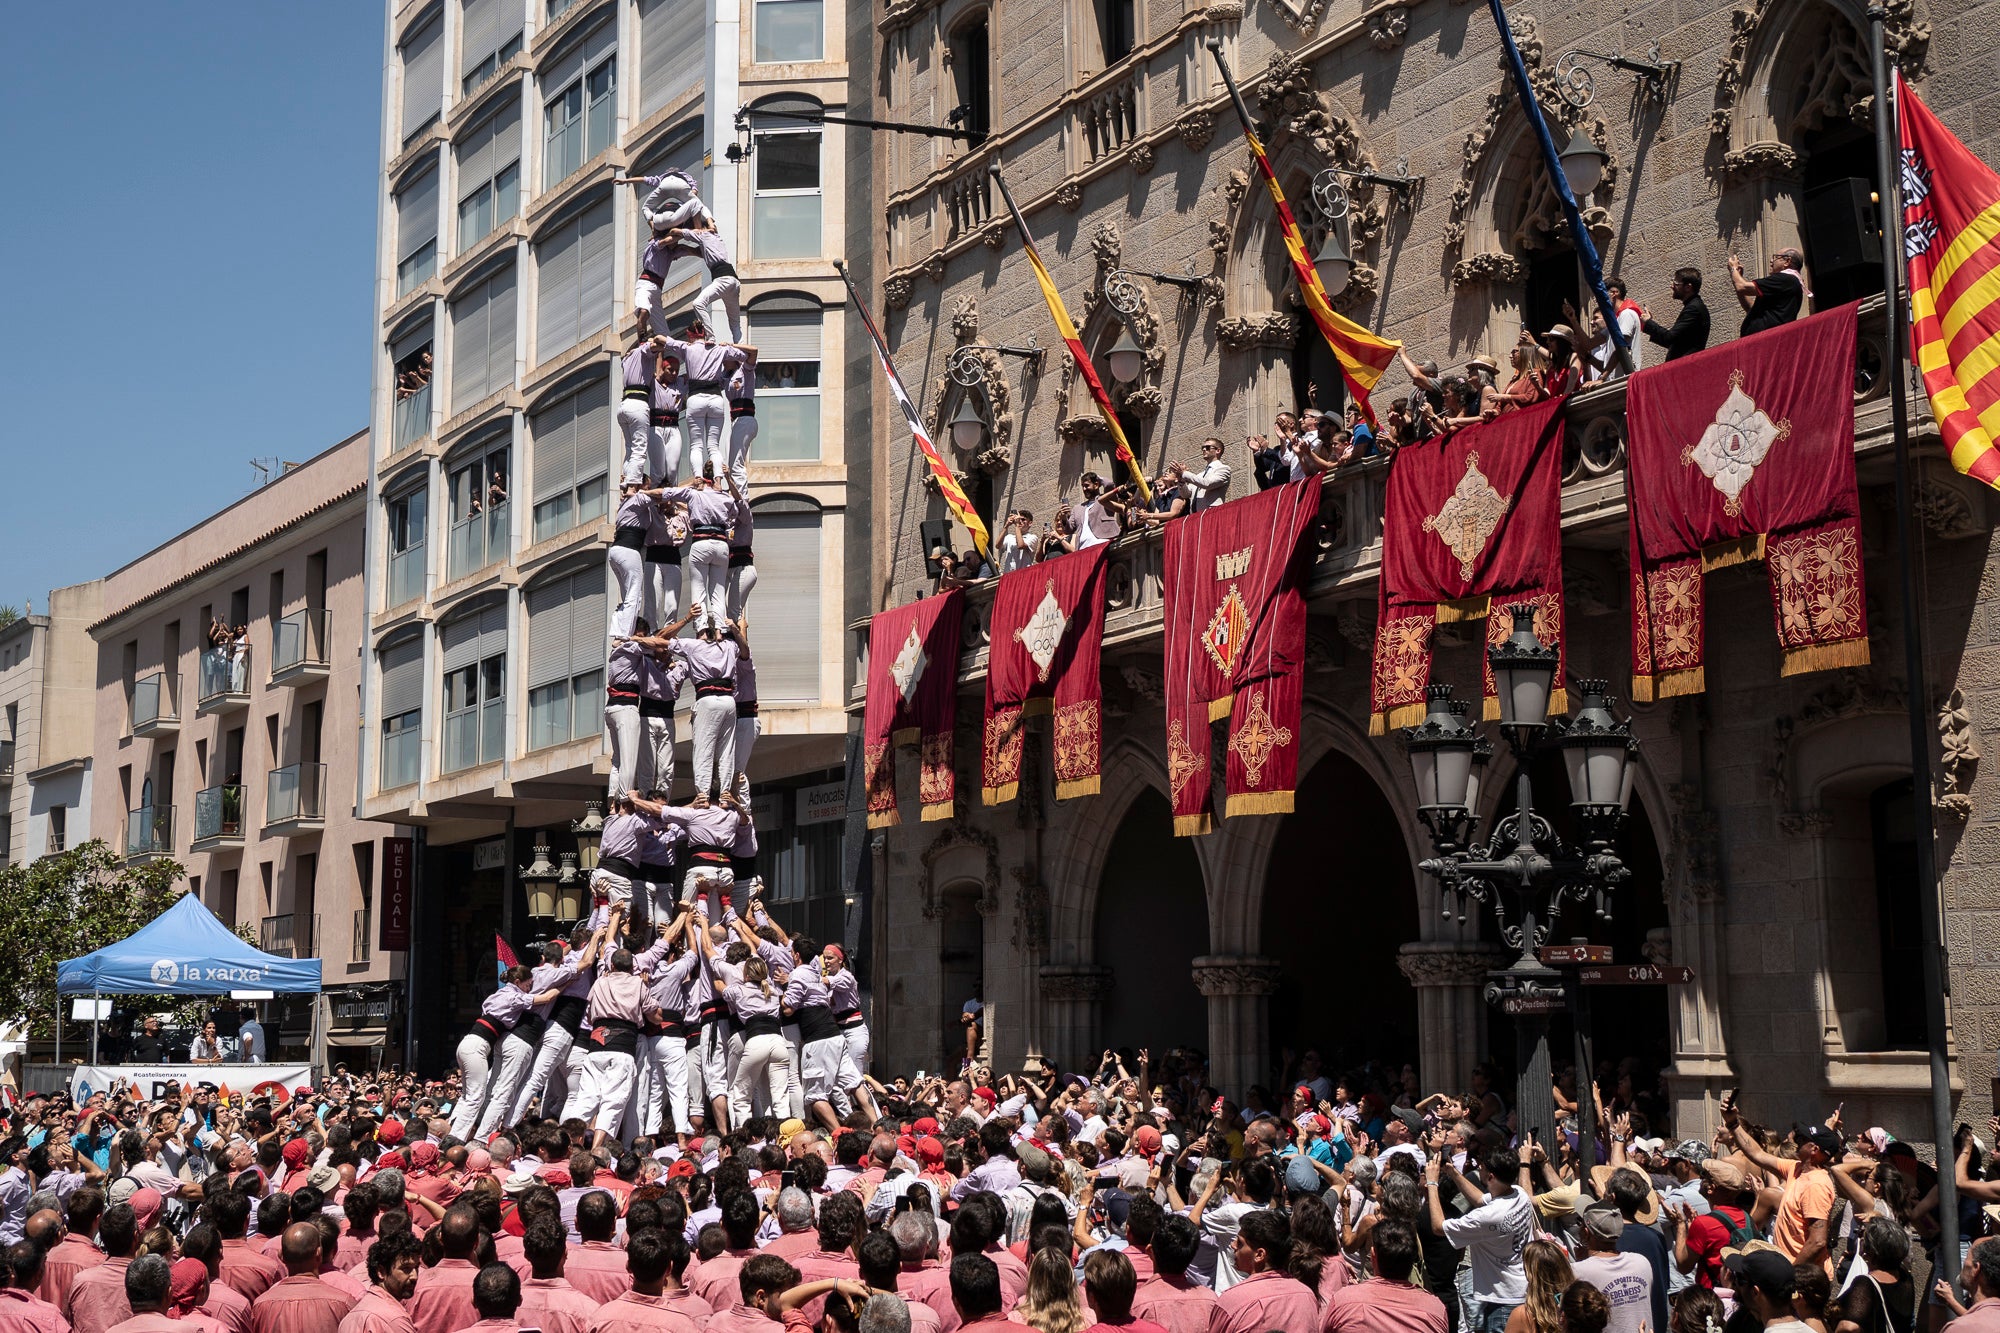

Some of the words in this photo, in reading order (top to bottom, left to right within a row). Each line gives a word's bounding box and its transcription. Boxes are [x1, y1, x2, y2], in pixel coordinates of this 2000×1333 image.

[808, 788, 845, 806] Advocats
[392, 843, 404, 928] MEDICAL
[183, 964, 201, 981] la
[1589, 970, 1601, 979] Vella
[337, 1003, 366, 1018] AMETLLER
[366, 1001, 390, 1017] ORIGEN
[1522, 1001, 1533, 1009] Plaça
[1614, 1276, 1632, 1285] SPORTS
[1632, 1275, 1648, 1289] SCHOOL
[1610, 1286, 1642, 1300] EDELWEISS
